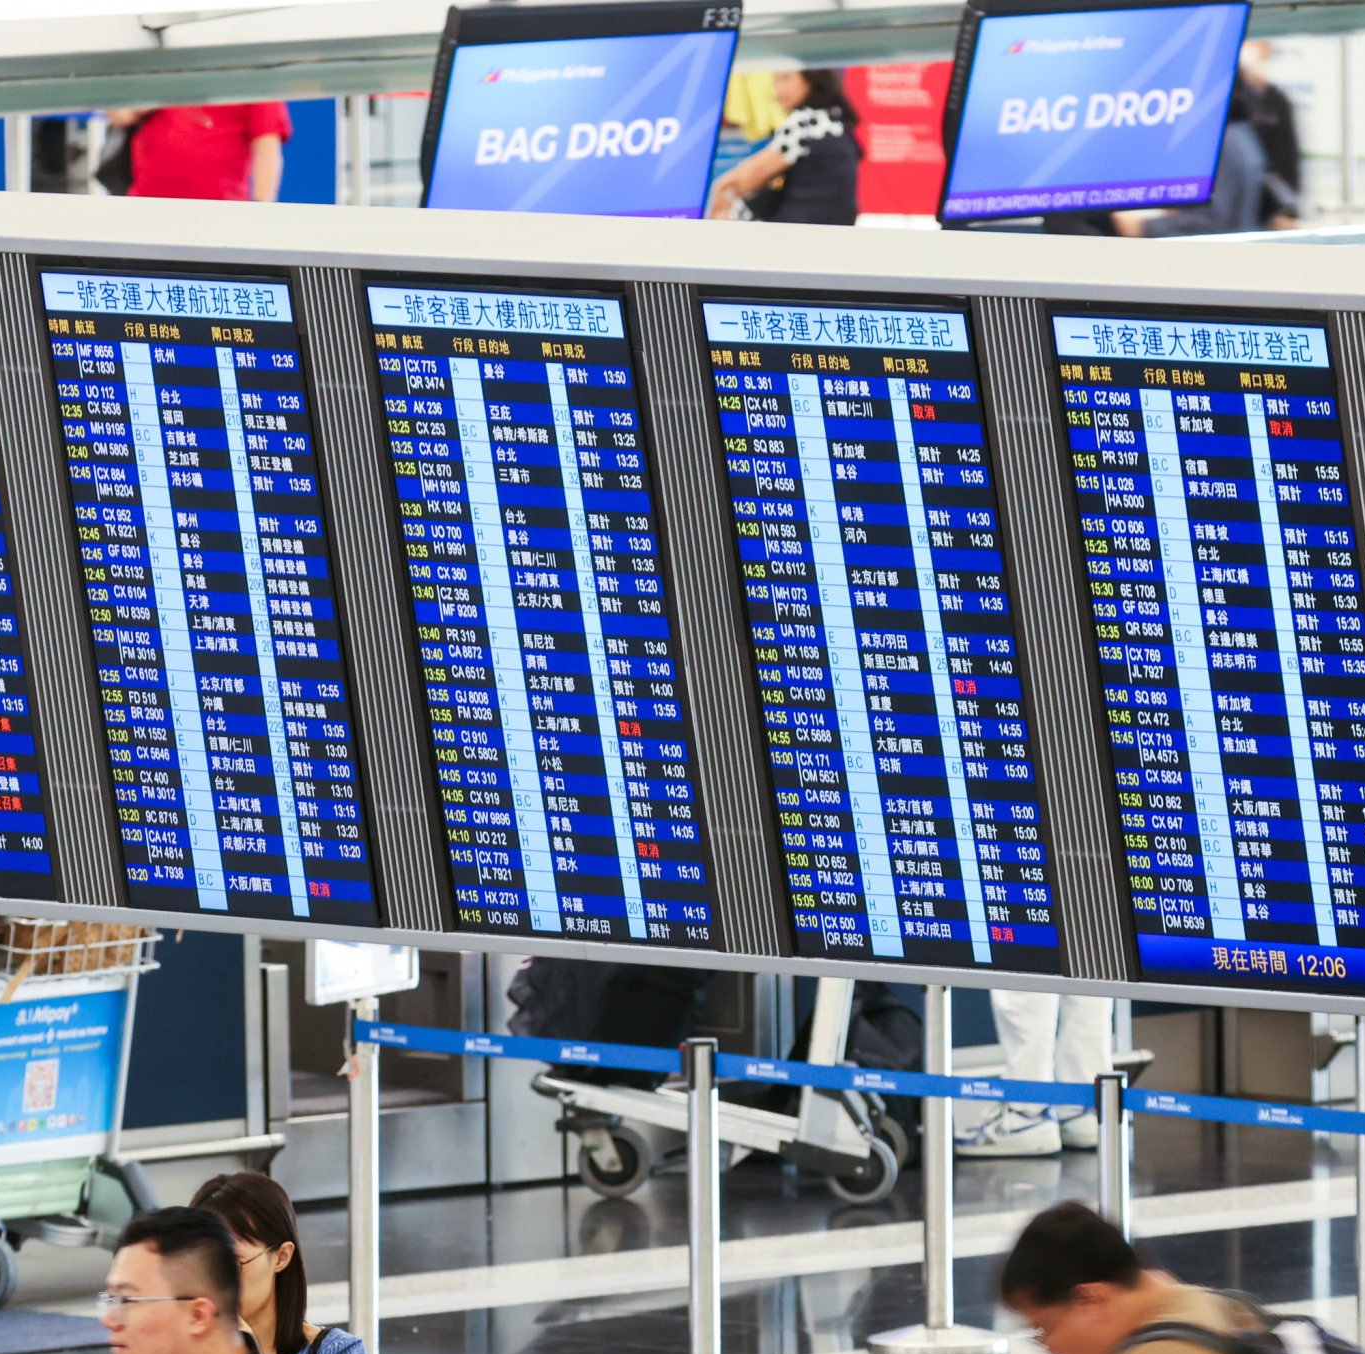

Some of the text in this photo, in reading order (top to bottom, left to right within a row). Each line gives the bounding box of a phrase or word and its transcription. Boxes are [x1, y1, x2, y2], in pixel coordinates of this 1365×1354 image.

[702, 7, 741, 28] F33
[997, 88, 1194, 135] BAG DROP
[475, 117, 681, 165] BAG DROP
[57, 281, 277, 317] 一號客運大樓航班登記
[384, 295, 609, 332] 一號客運大樓航班登記
[49, 320, 69, 334] 時間
[75, 320, 96, 335] 航班
[124, 322, 145, 337] 行段
[150, 324, 180, 339] 目的地
[720, 311, 953, 347] 一號客運大樓航班登記
[375, 334, 396, 348] 時間
[402, 335, 423, 349] 航班
[452, 337, 474, 352] 行段
[479, 339, 509, 354] 目的地
[1070, 324, 1313, 362] 一號客運大樓航班登記
[711, 350, 733, 365] 時間
[739, 352, 761, 366] 航班
[791, 354, 813, 369] 行段
[818, 355, 850, 370] 目的地
[1061, 365, 1083, 380] 時間
[1090, 366, 1112, 381] 航班
[1144, 368, 1167, 384] 行段
[1172, 370, 1205, 385] 目的地
[385, 400, 407, 412] 13:25
[413, 401, 425, 413] AK
[428, 402, 442, 415] 236
[489, 405, 511, 420] 亞庇
[573, 410, 594, 425] 預計
[610, 412, 632, 426] 13:25
[718, 397, 741, 409] 14:25
[747, 398, 760, 411] CX
[763, 399, 778, 412] 418
[826, 401, 873, 418] 首爾/仁川
[912, 404, 936, 420] 取消
[1064, 390, 1087, 404] 15:10
[1094, 392, 1107, 405] CZ
[1110, 392, 1131, 406] 6048
[1177, 396, 1212, 411] 哈爾濱
[1252, 399, 1263, 412] 50
[1267, 400, 1290, 415] 預計
[1306, 400, 1330, 415] 15:10
[64, 425, 85, 437] 12:40
[90, 422, 103, 434] MH
[105, 423, 125, 436] 9195
[165, 430, 197, 446] 吉隆坡
[247, 434, 268, 449] 預計
[283, 436, 305, 449] 12:40
[755, 648, 778, 661] 14:40
[784, 646, 796, 658] HX
[799, 647, 819, 659] 1636
[863, 654, 919, 671] 斯里巴加灣
[950, 658, 973, 673] 預計
[989, 660, 1013, 674] 14:40
[1127, 855, 1151, 869] 16:00
[1157, 853, 1170, 866] CA
[1172, 854, 1193, 867] 6528
[1240, 862, 1264, 878] 杭州
[1331, 867, 1354, 884] 預計
[1212, 947, 1346, 979] 現在時間 12:06
